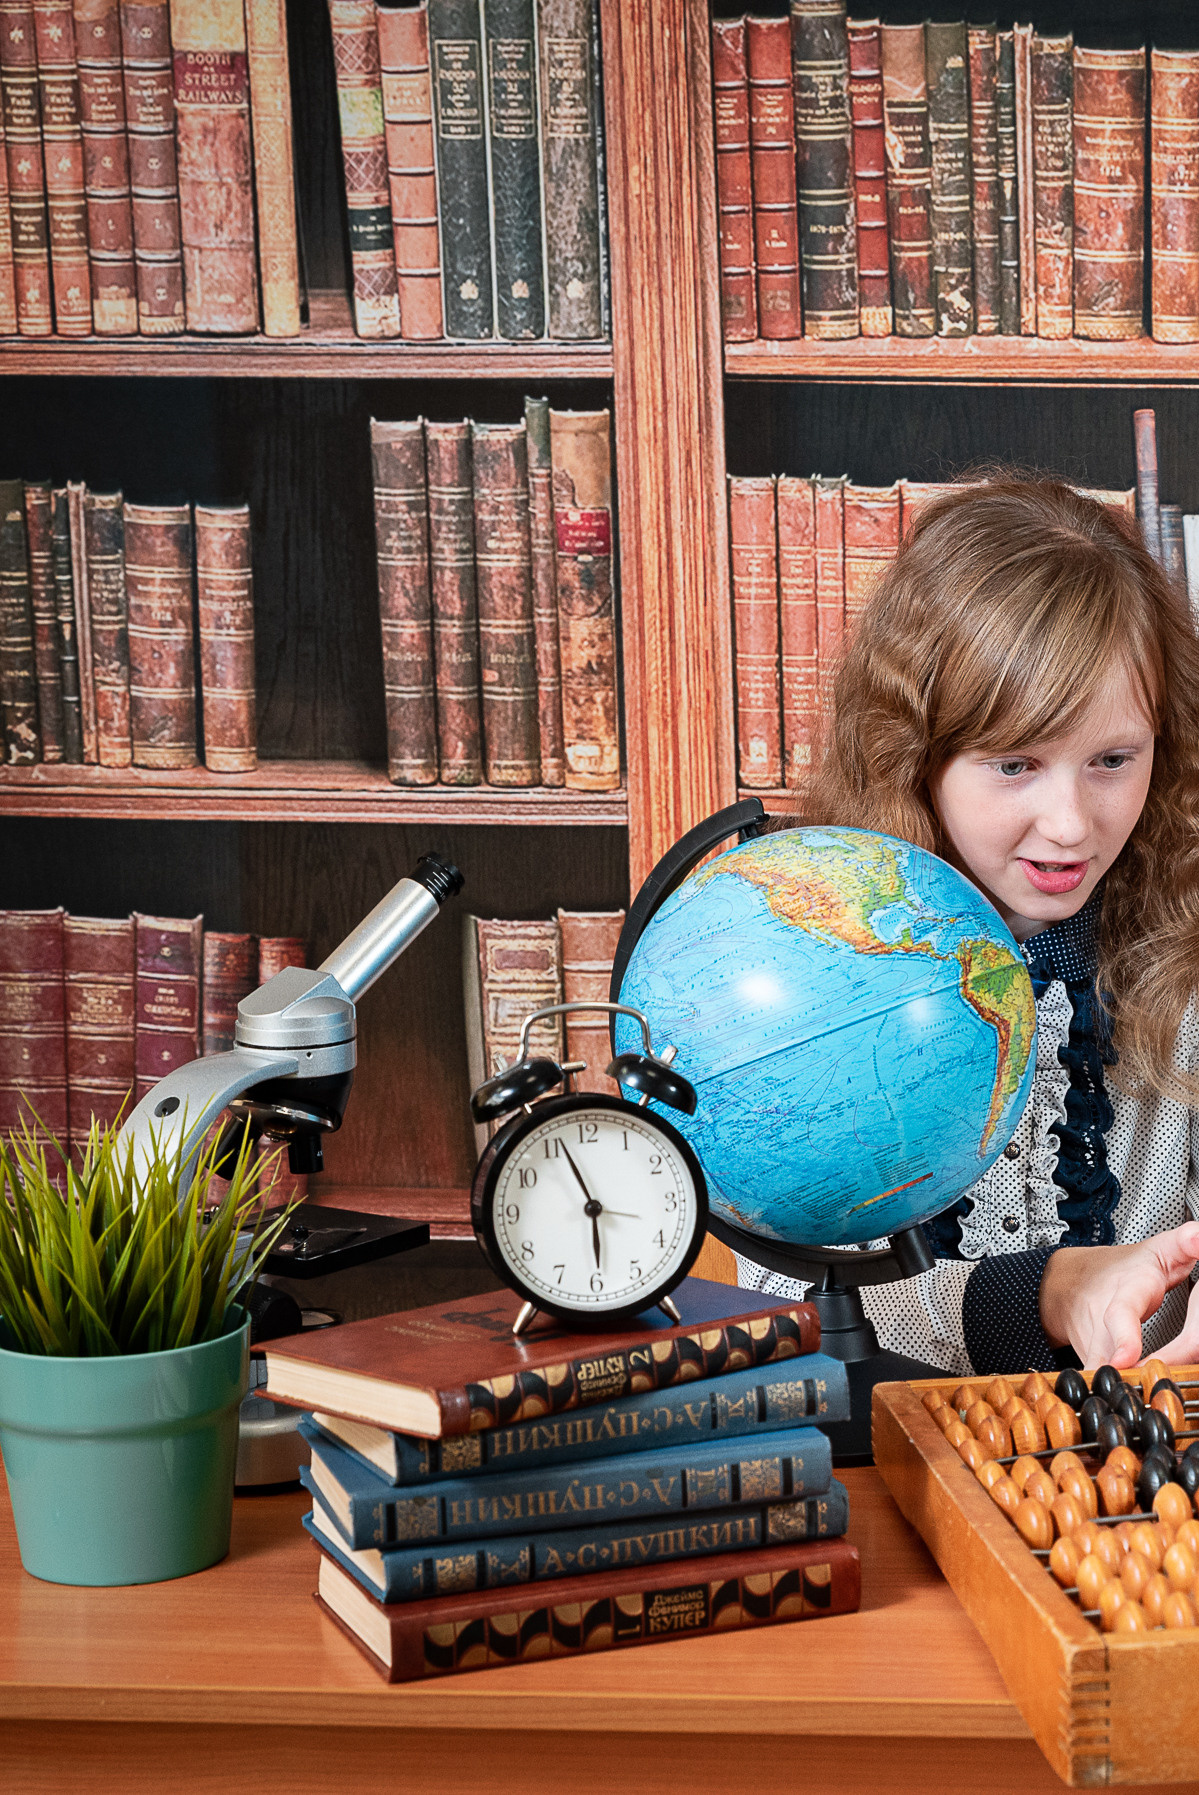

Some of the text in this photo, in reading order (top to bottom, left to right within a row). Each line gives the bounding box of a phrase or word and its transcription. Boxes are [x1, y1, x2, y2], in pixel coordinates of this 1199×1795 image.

[187, 53, 231, 65] BOOTH
[184, 71, 236, 87] STREET
[178, 89, 242, 103] RAILWAYS
[577, 1123, 598, 1144] 12
[622, 1131, 629, 1151] 1
[543, 1138, 560, 1159] 11
[649, 1155, 662, 1175] 2
[518, 1168, 537, 1189] 10
[664, 1192, 677, 1213] 3
[506, 1204, 520, 1225] 9
[652, 1229, 666, 1249] 4
[521, 1241, 535, 1261] 8
[553, 1264, 566, 1285] 7
[629, 1260, 642, 1281] 5
[590, 1273, 604, 1293] 6
[577, 1355, 626, 1381] КУПЕР
[653, 1589, 705, 1606] Джеймс
[647, 1600, 705, 1617] Фенимор
[649, 1609, 707, 1634] КУПЕР
